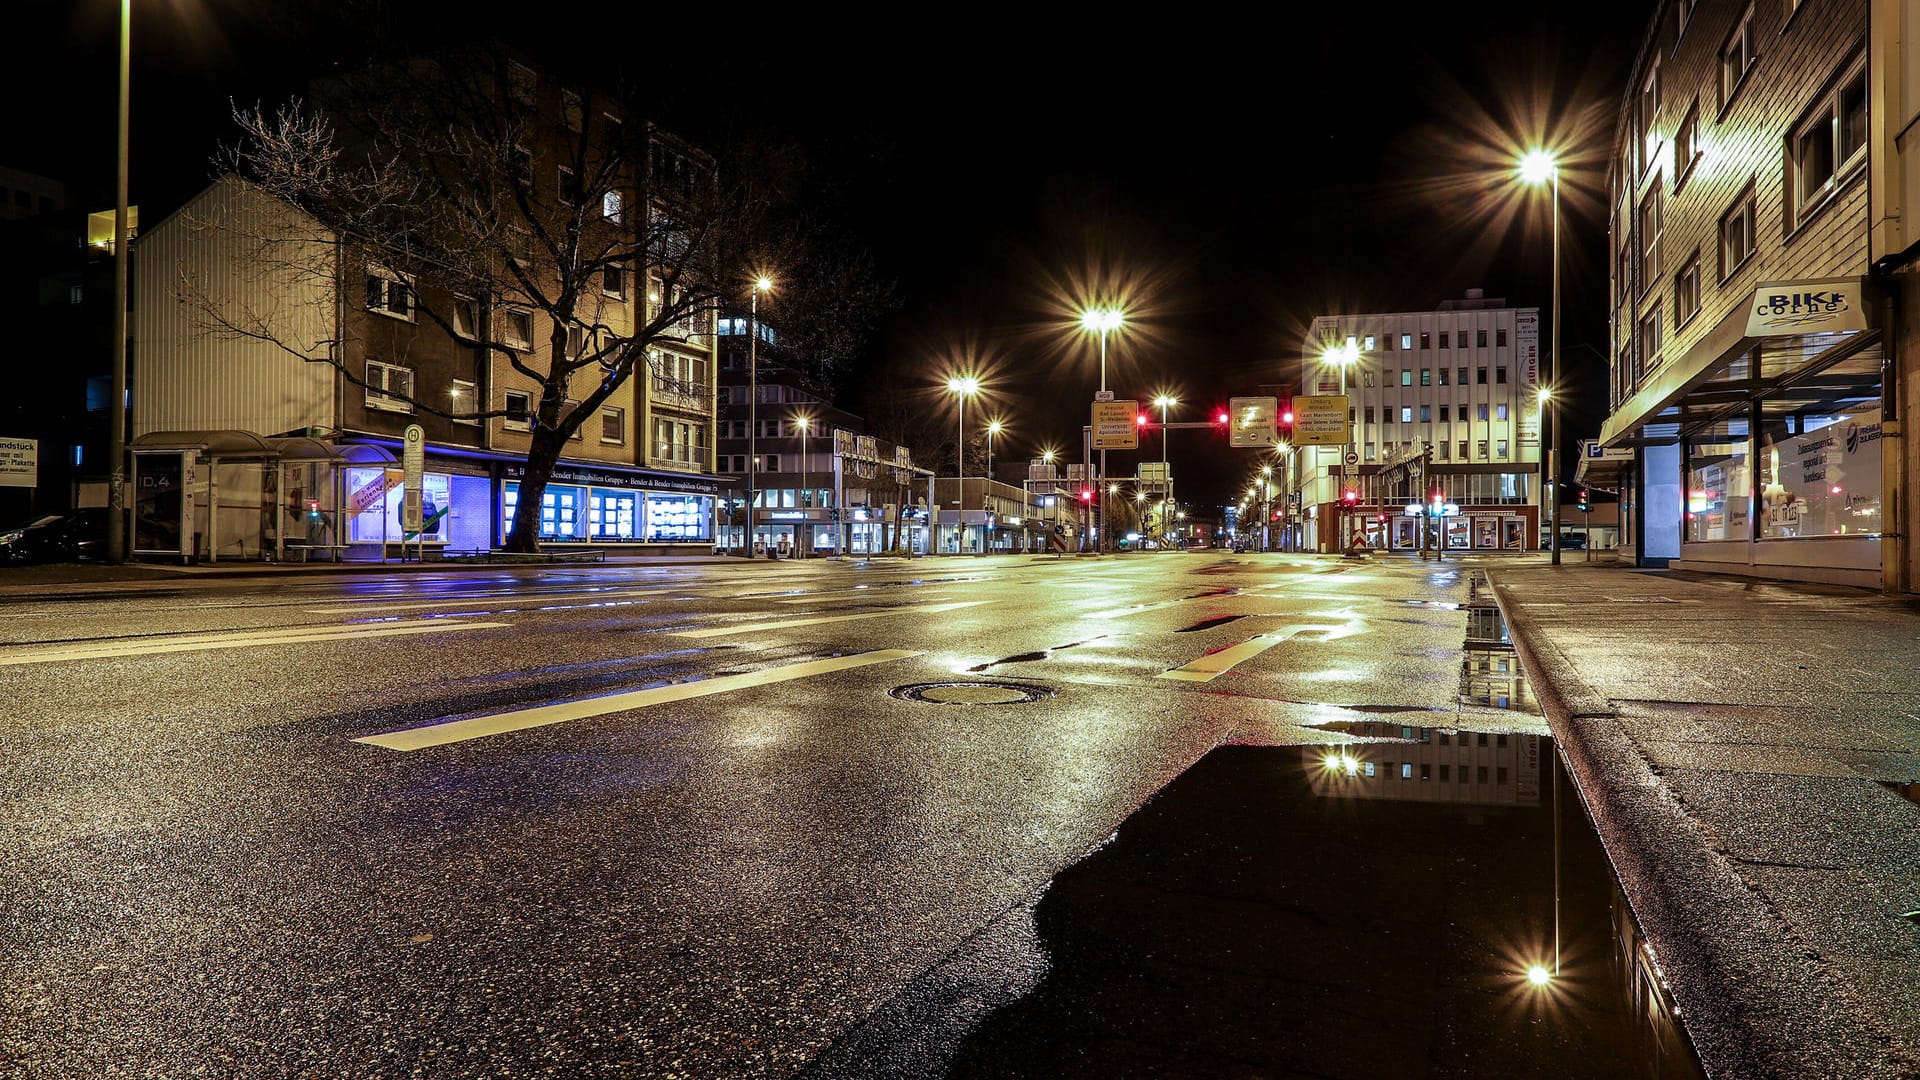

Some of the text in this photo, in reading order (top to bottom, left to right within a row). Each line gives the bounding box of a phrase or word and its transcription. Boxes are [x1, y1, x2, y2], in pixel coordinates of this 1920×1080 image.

[1768, 291, 1845, 307] BIKE
[0, 442, 34, 451] ndstück
[1590, 444, 1601, 457] P
[140, 476, 170, 488] ID.4
[572, 472, 604, 482] Immobilien
[604, 475, 624, 486] Gruppe
[630, 477, 648, 486] Bender
[654, 480, 670, 488] Bender
